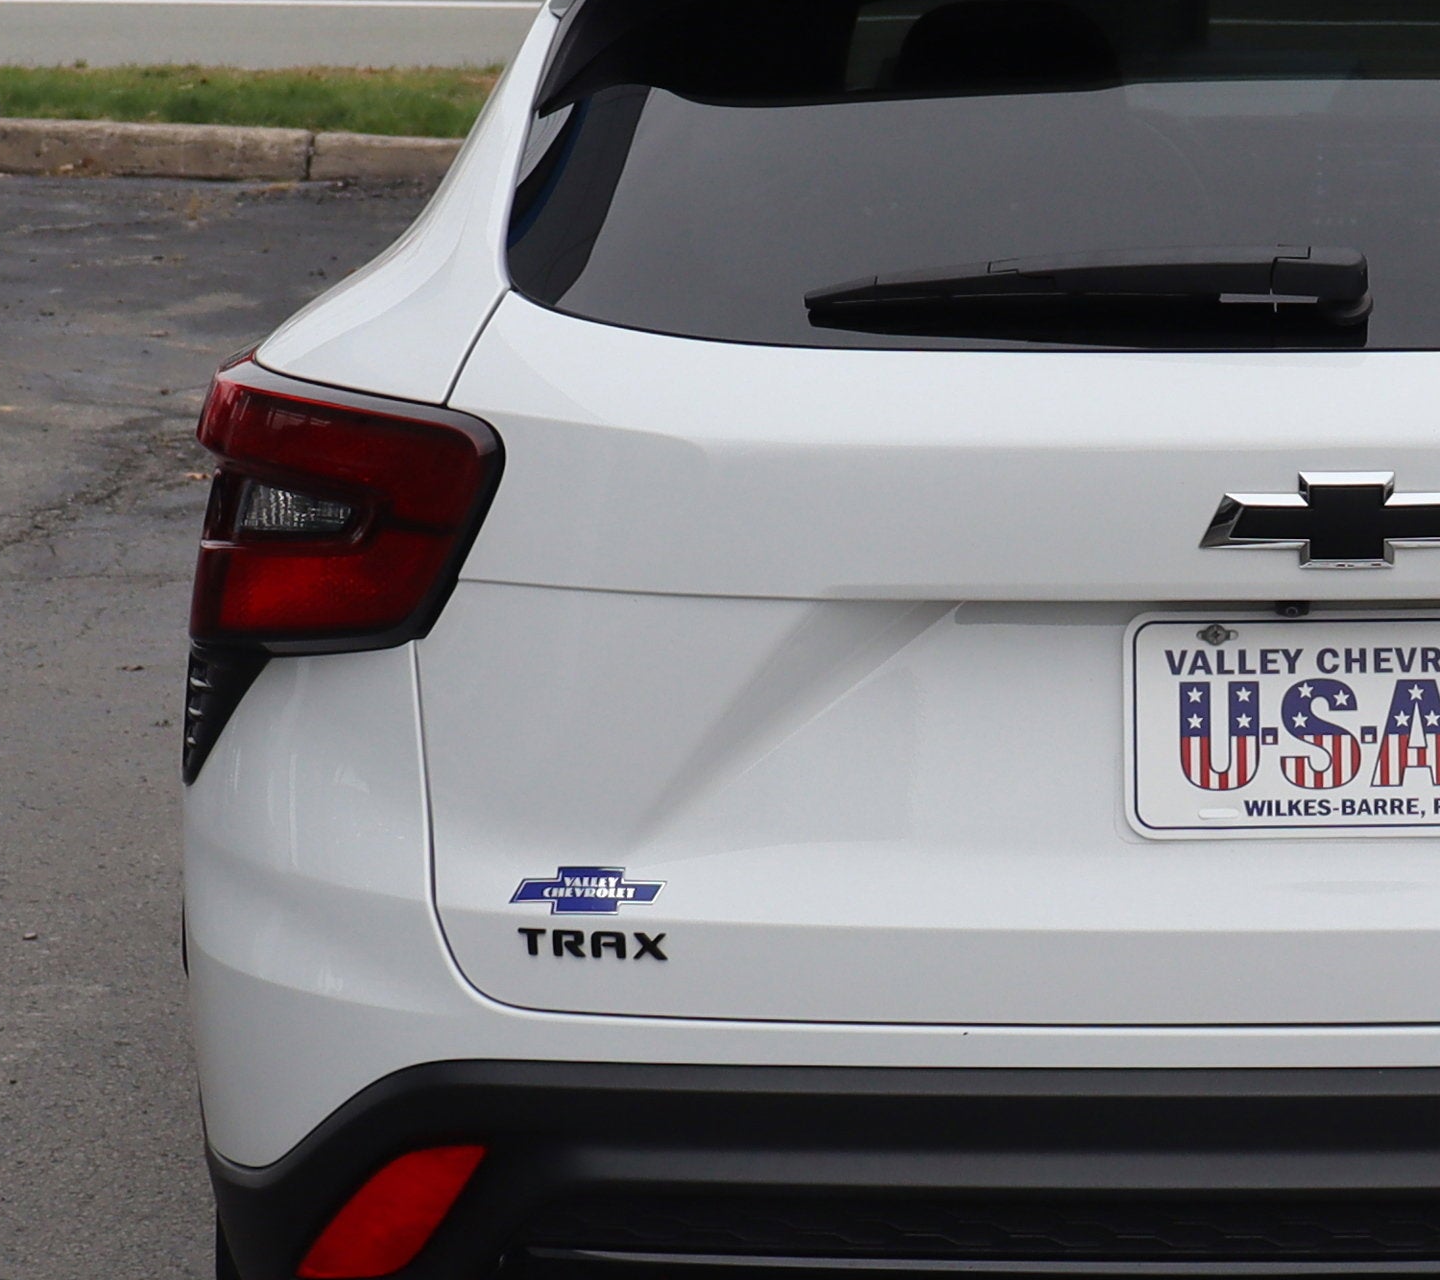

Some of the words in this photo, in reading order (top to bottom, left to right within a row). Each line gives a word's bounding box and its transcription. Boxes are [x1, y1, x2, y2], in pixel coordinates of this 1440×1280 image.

[1164, 647, 1304, 677] VALLEY
[1244, 798, 1427, 819] WILKES-BARRE,
[542, 885, 637, 900] CHEVROLET
[563, 875, 619, 889] VALLEY
[518, 927, 669, 961] TRAX
